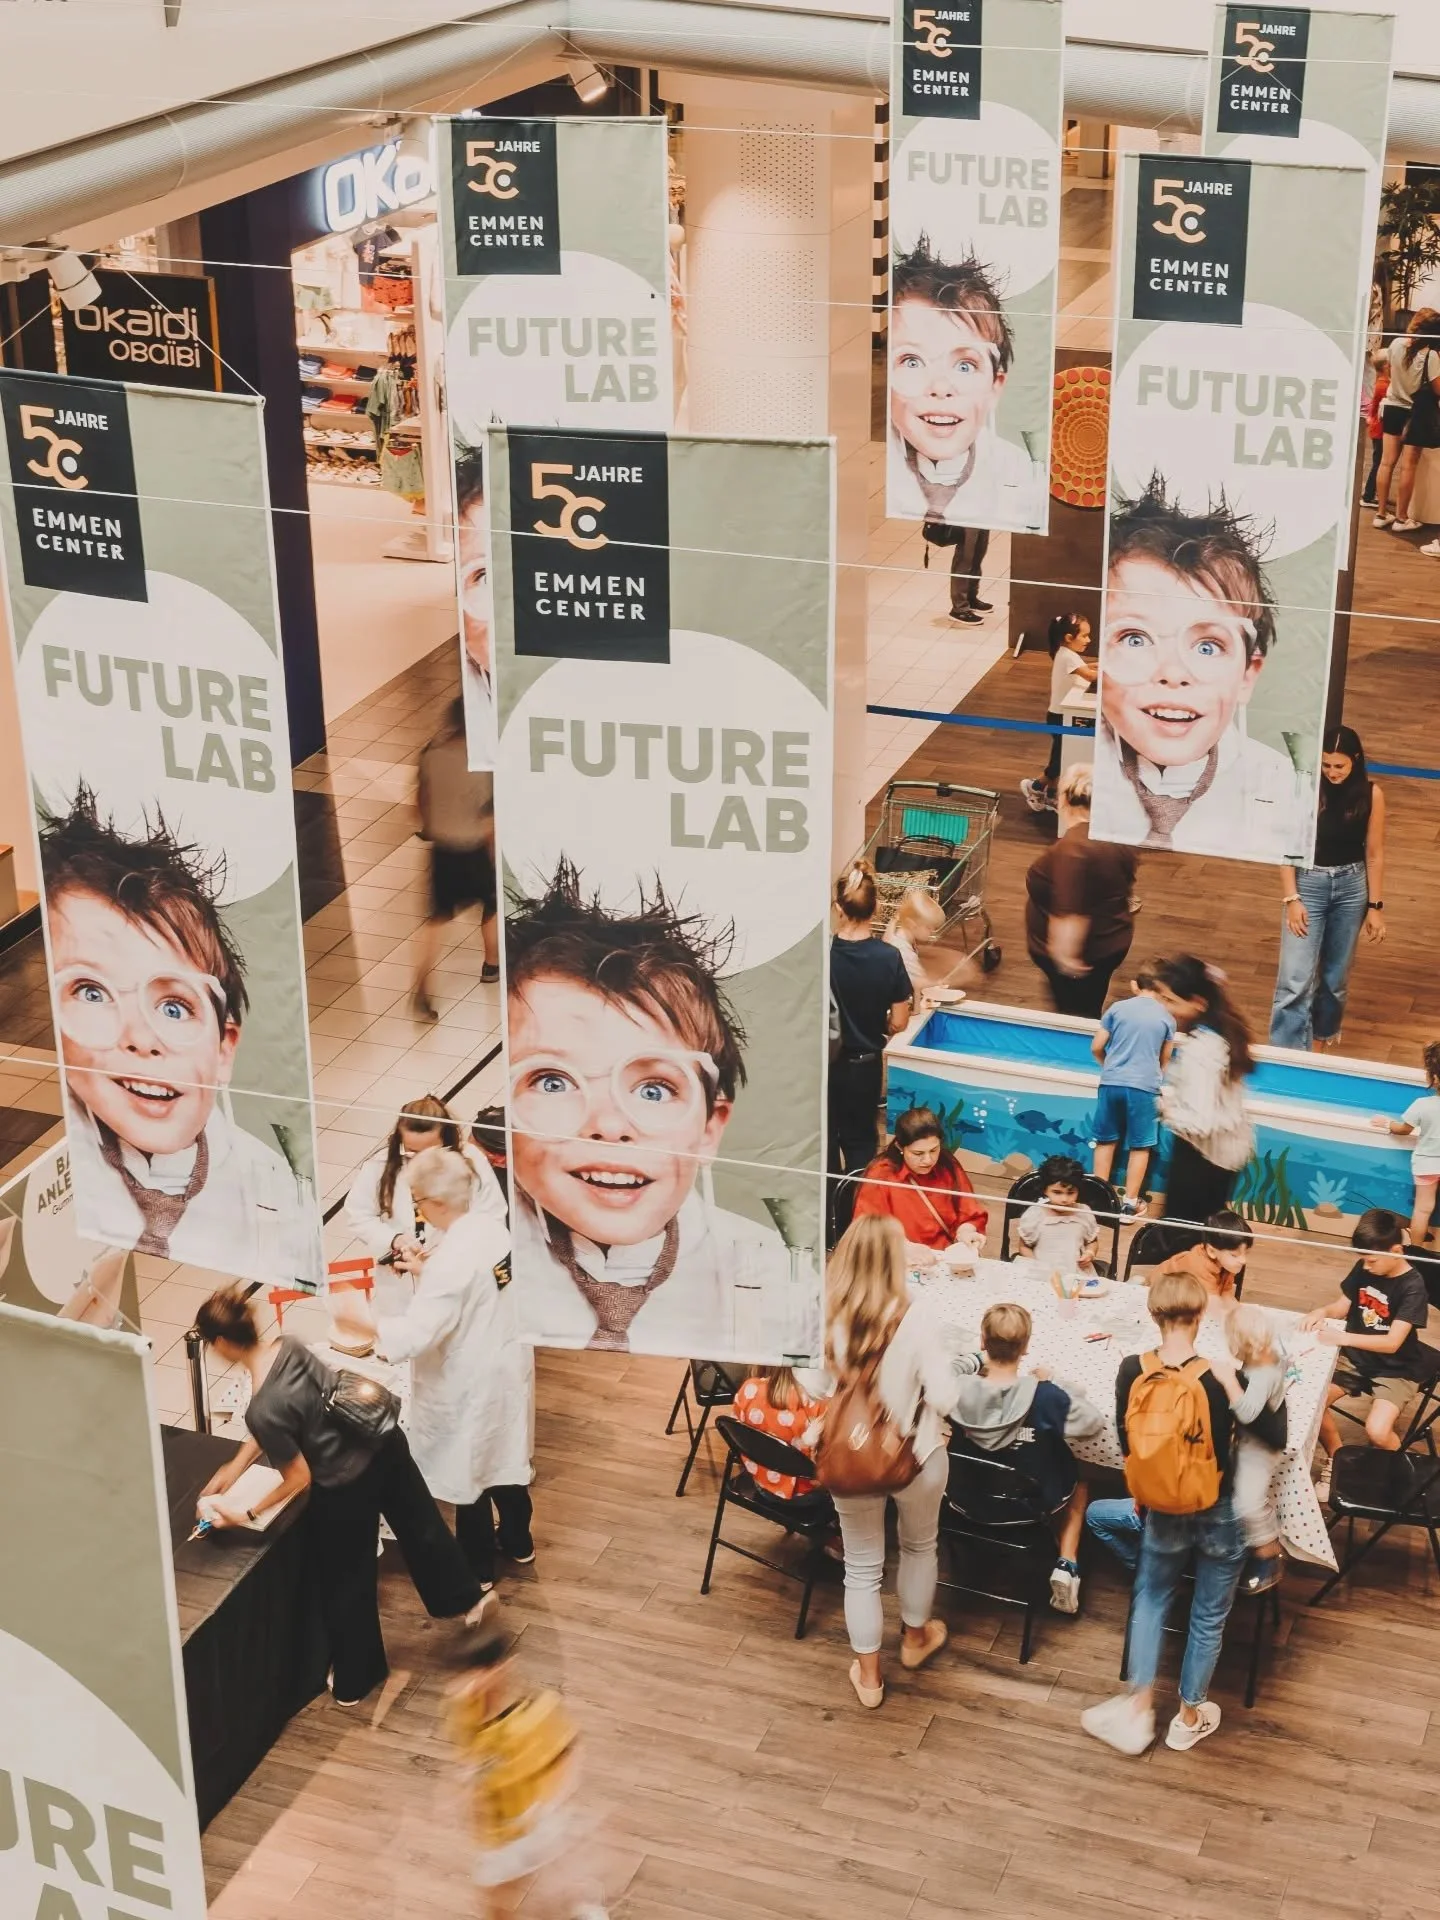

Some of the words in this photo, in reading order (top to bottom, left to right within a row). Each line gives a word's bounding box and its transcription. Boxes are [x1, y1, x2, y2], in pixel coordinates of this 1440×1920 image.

[935, 10, 970, 21] JAHRE
[1259, 24, 1297, 36] JAHRE
[912, 69, 970, 84] EMMEN
[912, 83, 969, 97] CENTER
[1230, 84, 1291, 100] EMMEN
[1230, 99, 1290, 114] CENTER
[495, 140, 541, 153] JAHRE
[907, 150, 1050, 191] FUTURE
[1183, 181, 1233, 196] JAHRE
[978, 192, 1049, 228] LAB
[468, 215, 544, 231] EMMEN
[469, 234, 545, 247] CENTER
[1150, 258, 1229, 279] EMMEN
[1149, 277, 1228, 296] CENTER
[467, 317, 657, 357] FUTURE
[564, 364, 659, 403] LAB
[1136, 364, 1339, 422] FUTURE
[54, 409, 109, 431] JAHRE
[1233, 423, 1334, 470] LAB
[574, 465, 644, 484] JAHRE
[32, 507, 123, 539] EMMEN
[35, 533, 125, 561] CENTER
[534, 571, 646, 597] EMMEN
[535, 598, 646, 621] CENTER
[41, 644, 272, 733] FUTURE
[161, 725, 277, 794] LAB
[528, 716, 811, 789] FUTURE
[670, 792, 810, 854] LAB
